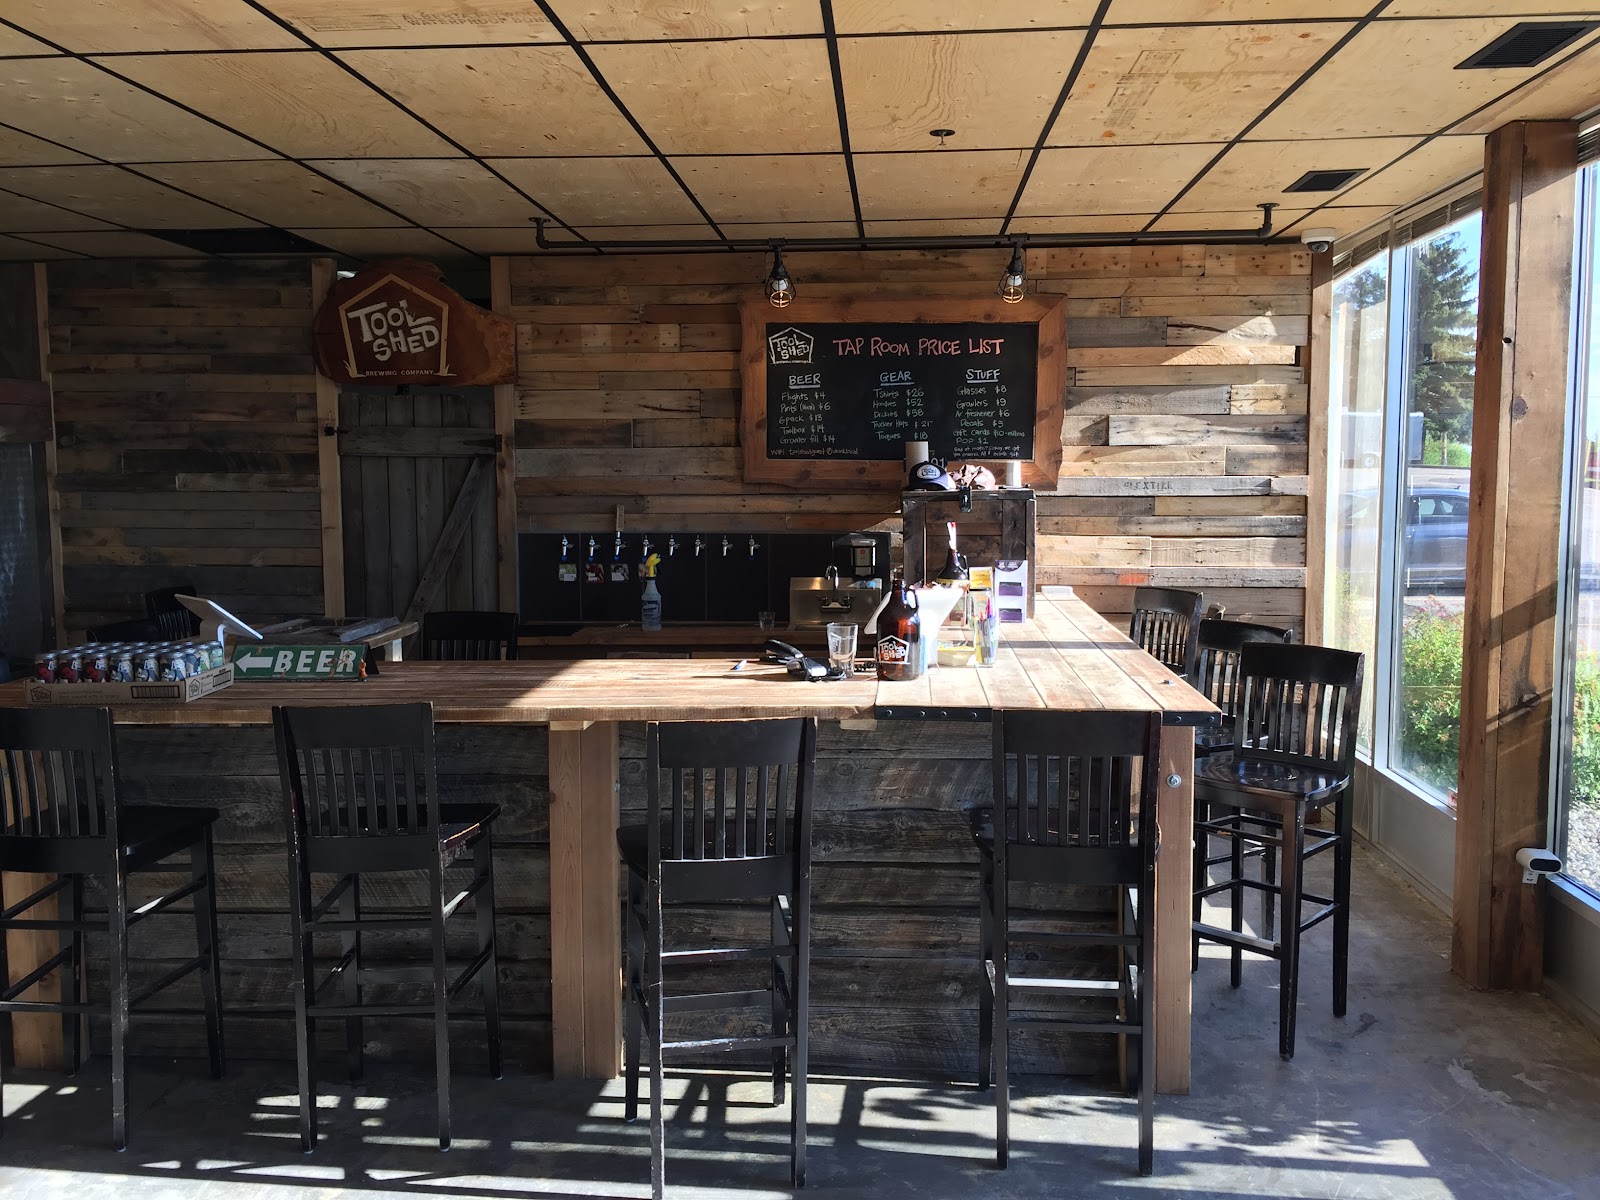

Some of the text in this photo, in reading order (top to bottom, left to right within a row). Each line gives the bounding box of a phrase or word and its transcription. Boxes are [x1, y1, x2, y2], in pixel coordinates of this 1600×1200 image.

[406, 17, 507, 26] WATERPROOF
[347, 300, 436, 343] TOOL
[372, 325, 440, 361] SHED
[772, 334, 806, 352] TOOL
[832, 338, 864, 356] TAP
[918, 338, 960, 356] PRICE
[968, 338, 1004, 356] LIST
[780, 343, 810, 360] SHED
[788, 373, 822, 386] BEER
[880, 370, 912, 382] GEAR
[966, 368, 1000, 380] STUFF
[906, 388, 924, 397] $26
[957, 384, 1007, 396] Glasses $8
[781, 392, 826, 404] Flights $4
[906, 398, 924, 406] $52
[956, 398, 1007, 410] Growlers $9
[780, 404, 797, 414] Pints
[818, 402, 831, 411] $6
[906, 408, 924, 418] $58
[964, 409, 996, 418] freshener
[998, 409, 1010, 418] $6
[778, 414, 822, 425] 6pack $13
[871, 420, 894, 428] Trucker
[896, 419, 909, 428] Hats
[960, 419, 1004, 428] Decals $5
[780, 424, 825, 435] Toolbox $14
[876, 430, 928, 441] Toques $18
[780, 434, 836, 444] Growler fill $14
[884, 646, 906, 660] SHED
[274, 650, 357, 673] BEER
